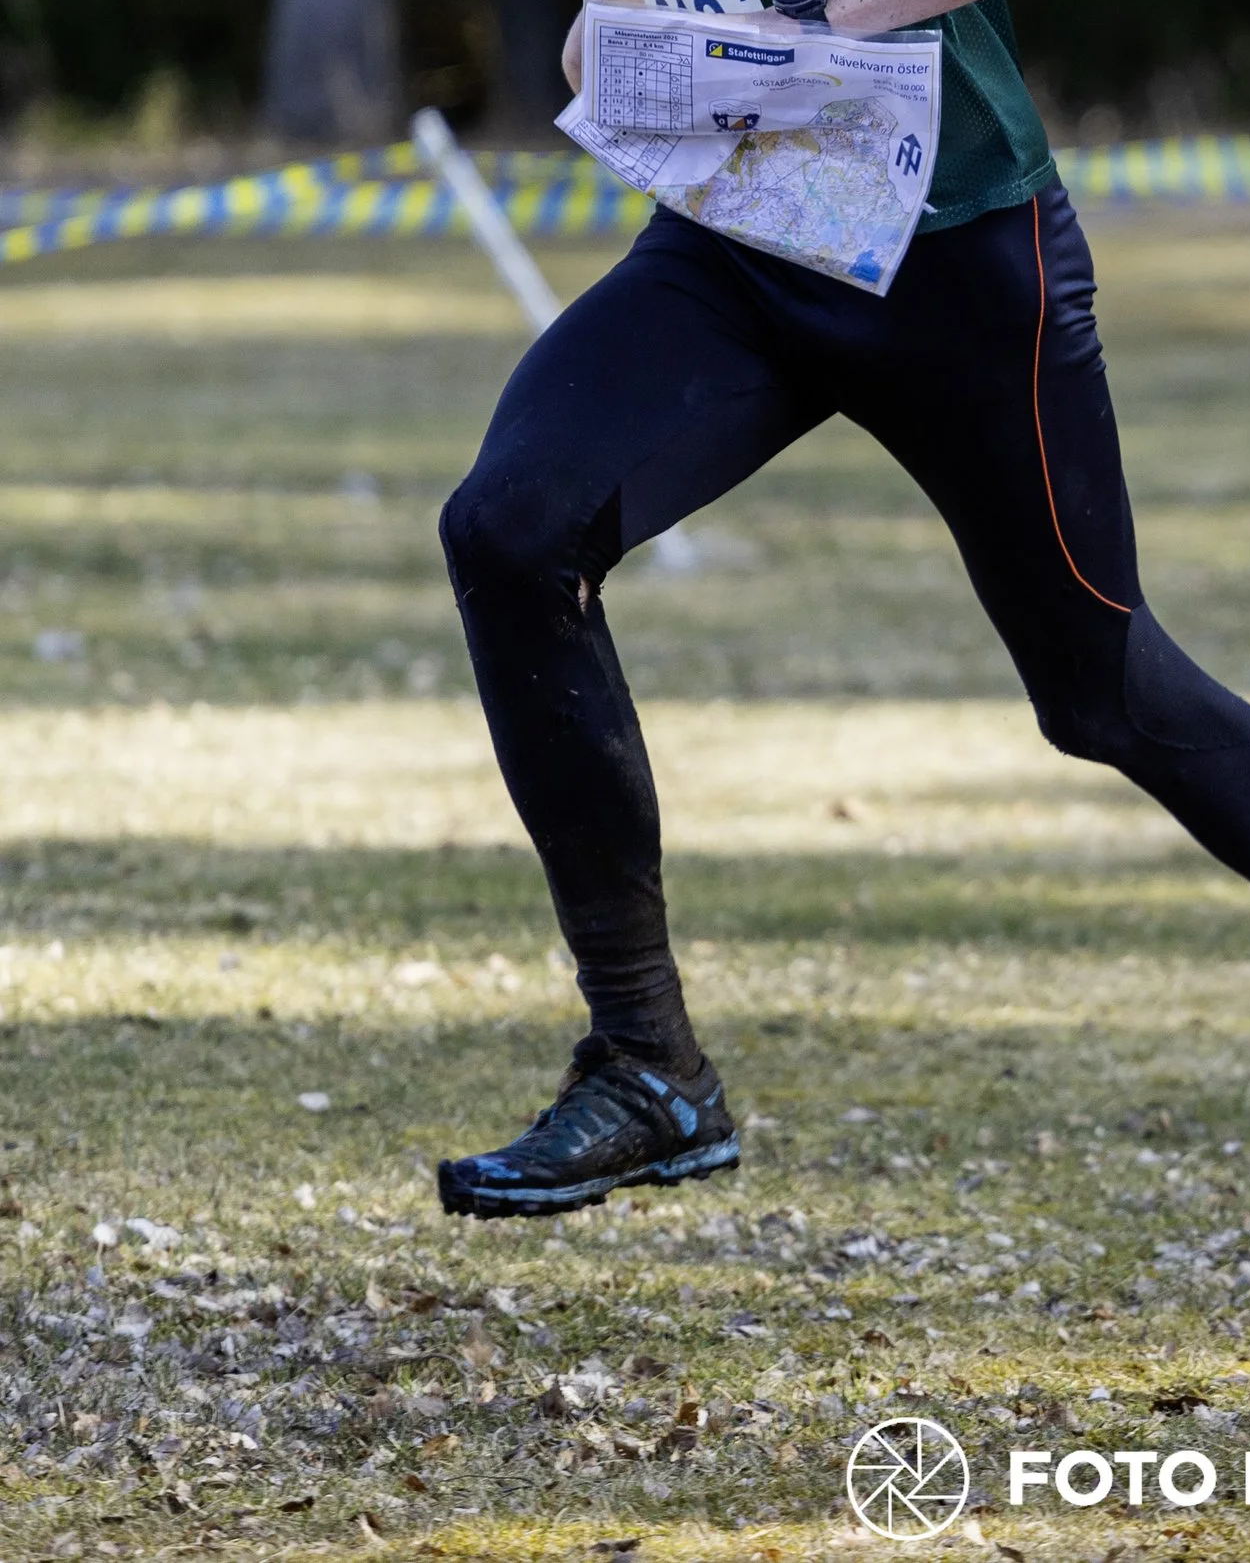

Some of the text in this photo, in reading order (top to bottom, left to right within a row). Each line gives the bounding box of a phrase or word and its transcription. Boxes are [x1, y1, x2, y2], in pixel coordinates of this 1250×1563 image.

[728, 46, 786, 63] Stafettligan
[829, 53, 930, 75] Nävekvarn öster
[910, 84, 926, 92] 000
